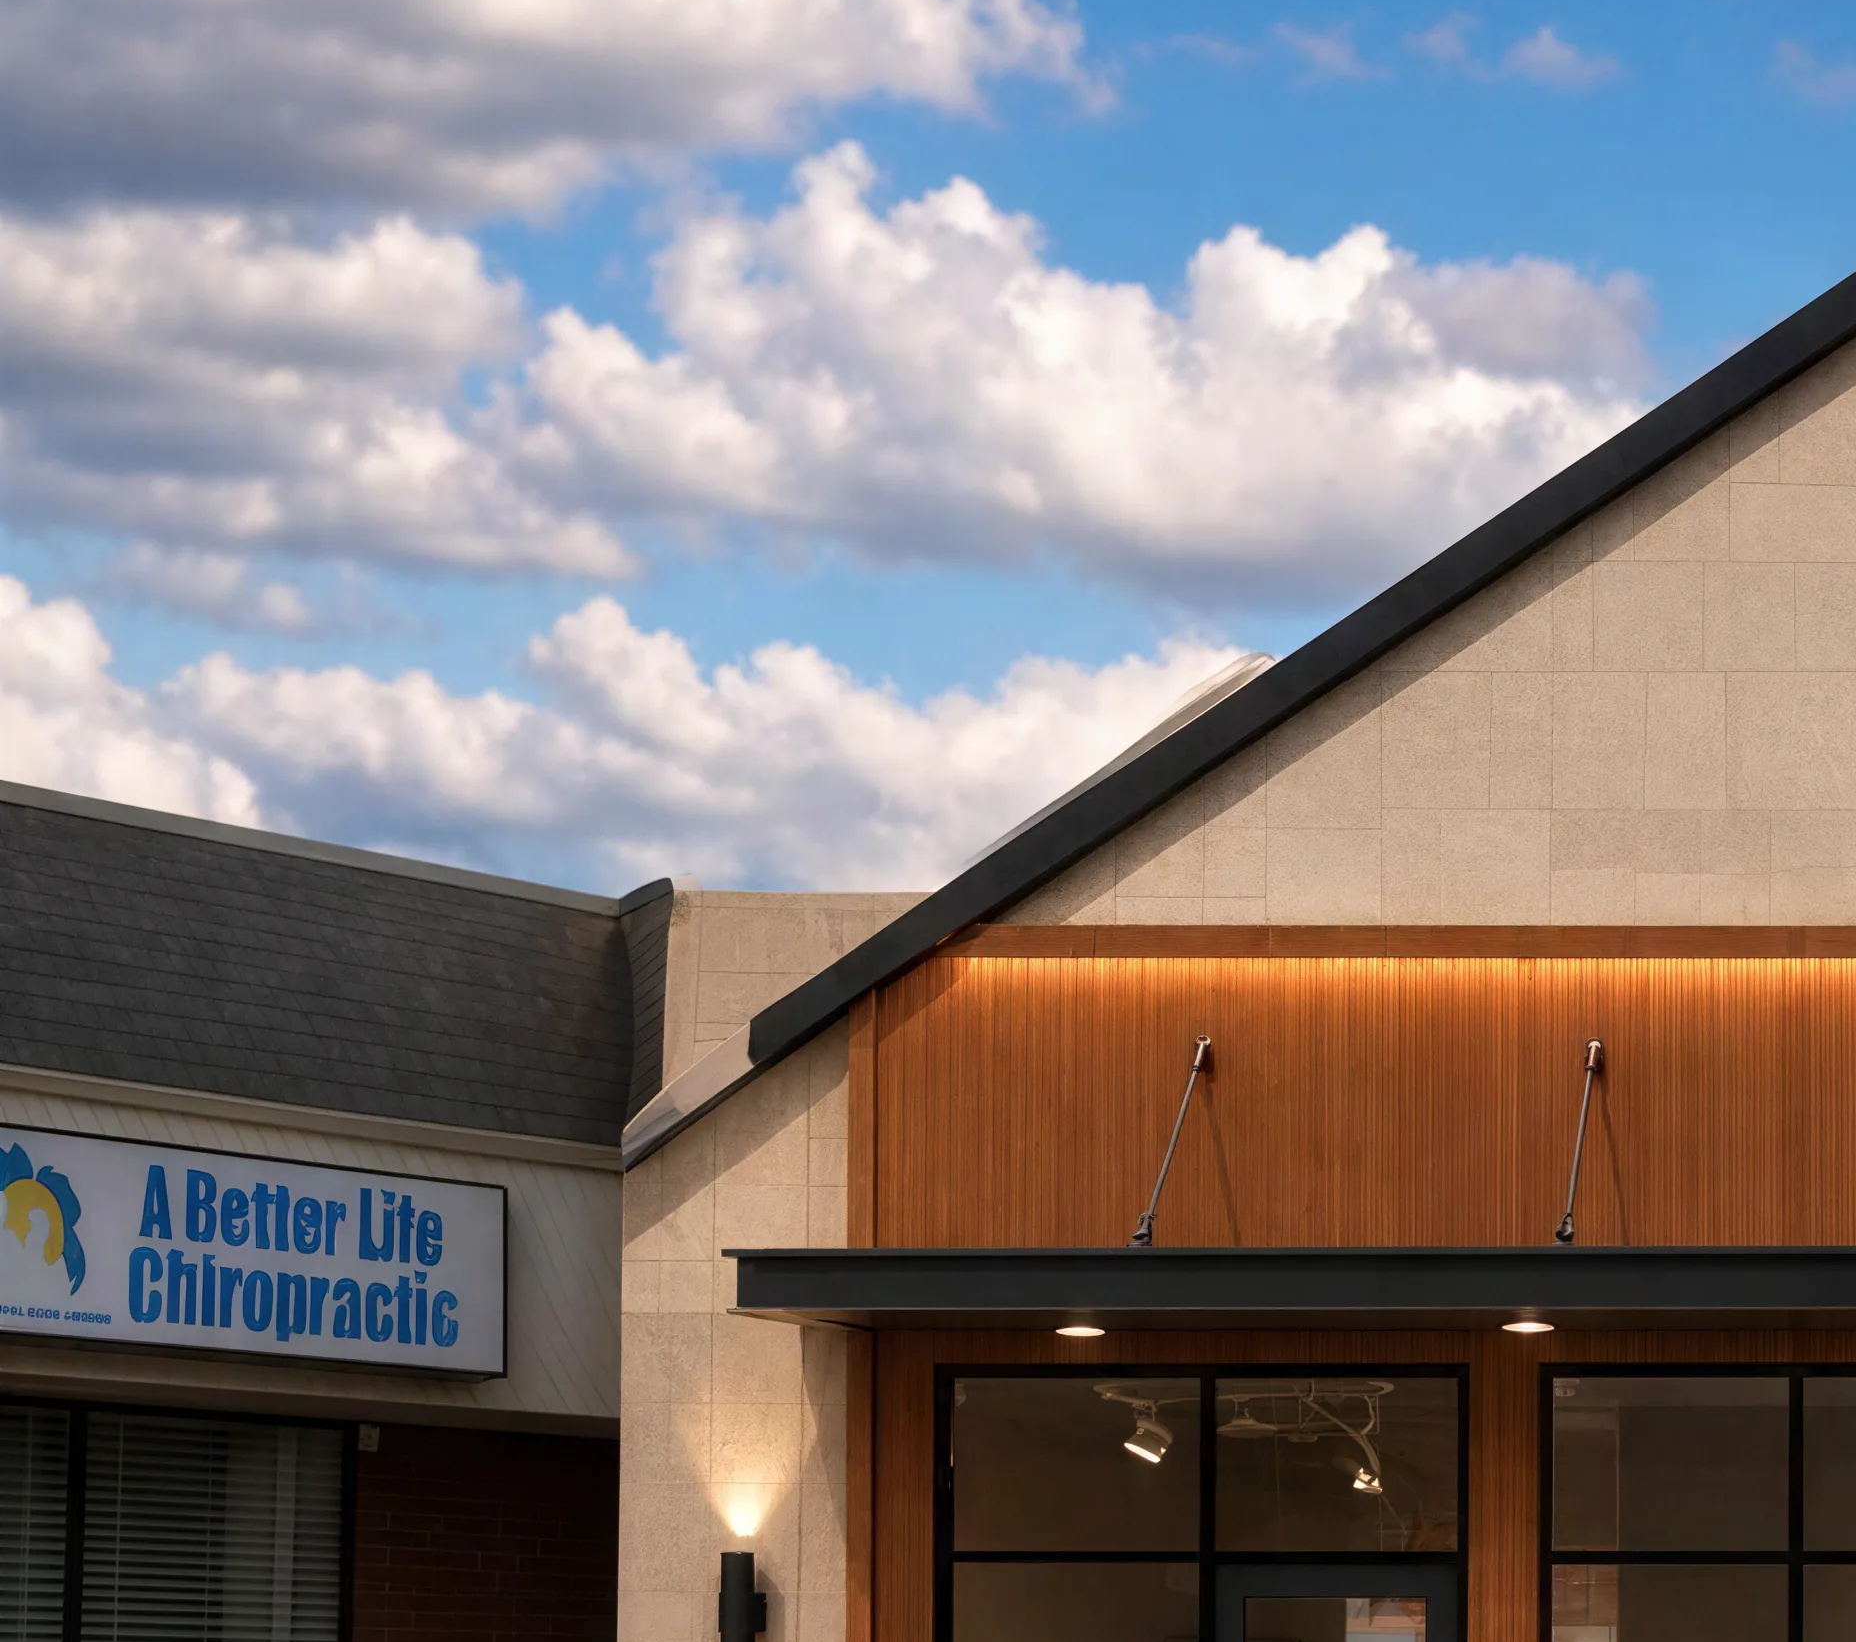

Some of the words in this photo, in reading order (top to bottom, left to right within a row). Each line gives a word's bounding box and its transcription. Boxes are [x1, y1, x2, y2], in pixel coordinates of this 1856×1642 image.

[138, 1164, 173, 1241] A
[185, 1168, 346, 1256] Better
[127, 1245, 459, 1348] Chiropractic
